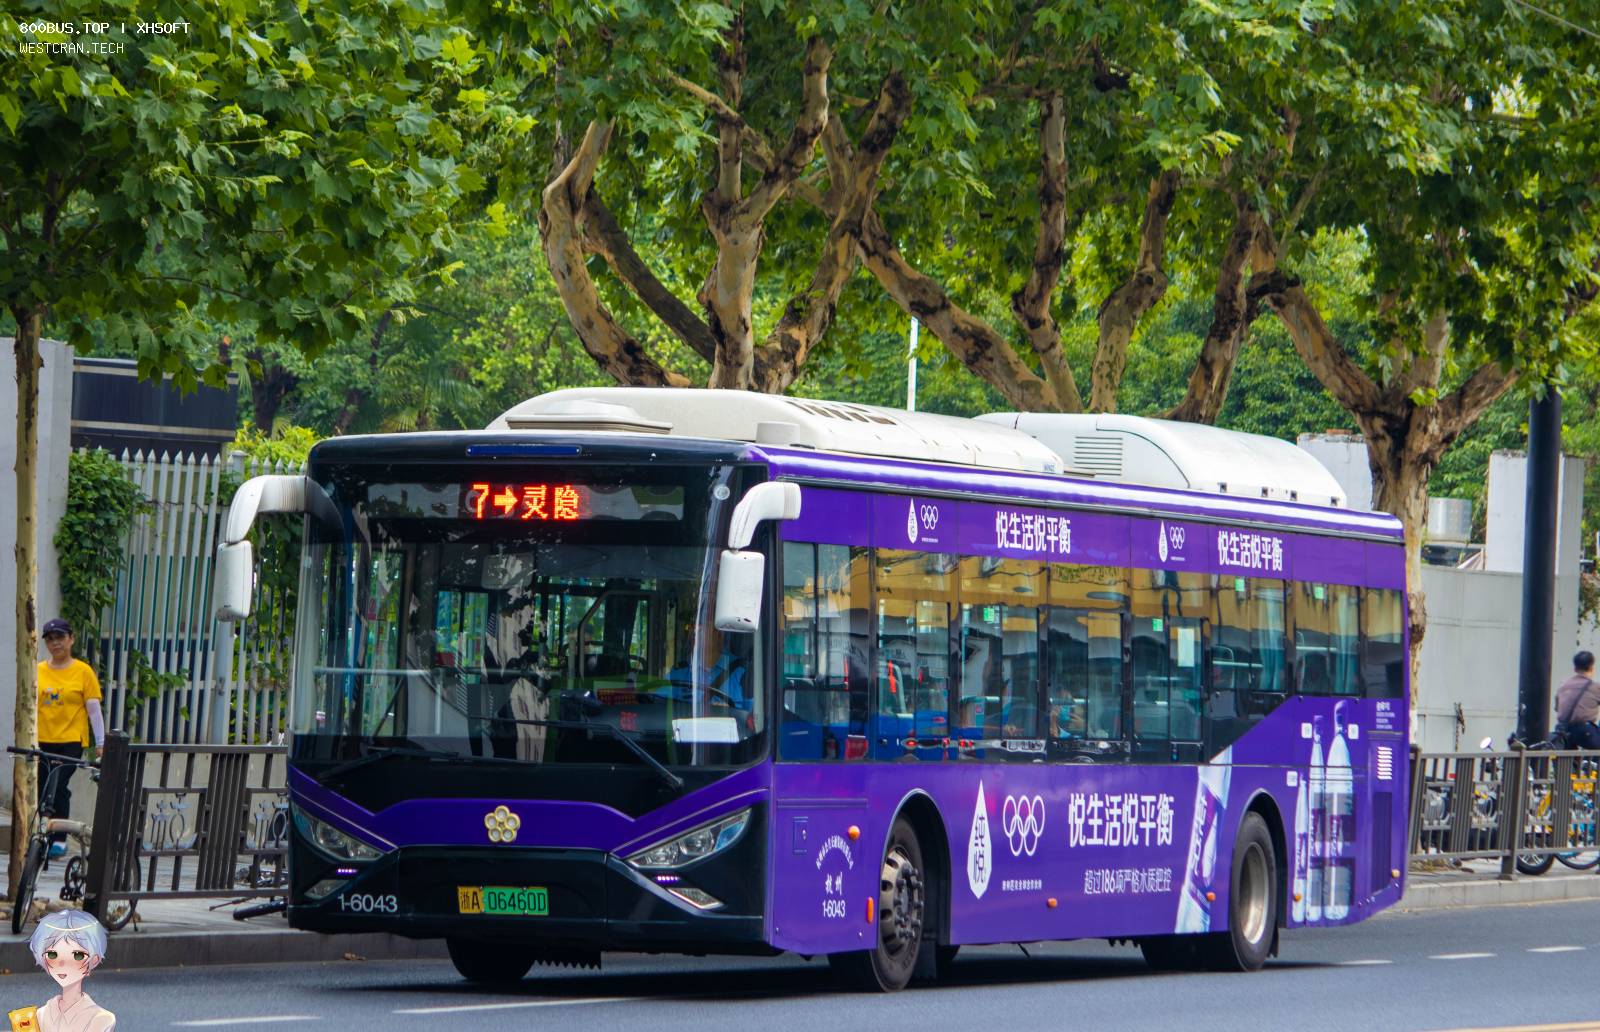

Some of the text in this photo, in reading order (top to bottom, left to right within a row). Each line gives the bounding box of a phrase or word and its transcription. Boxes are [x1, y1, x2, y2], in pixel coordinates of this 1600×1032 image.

[473, 484, 580, 520] 7 灵隐
[995, 511, 1071, 555] 悦生活悦平衡
[1217, 530, 1284, 572] 悦生活悦平衡
[1068, 793, 1175, 848] 悦生活悦平衡
[1084, 867, 1172, 895] 超过186项严格水质把控
[337, 893, 398, 913] 1-6043
[488, 891, 546, 912] 06460D
[822, 899, 846, 918] 1-6043
